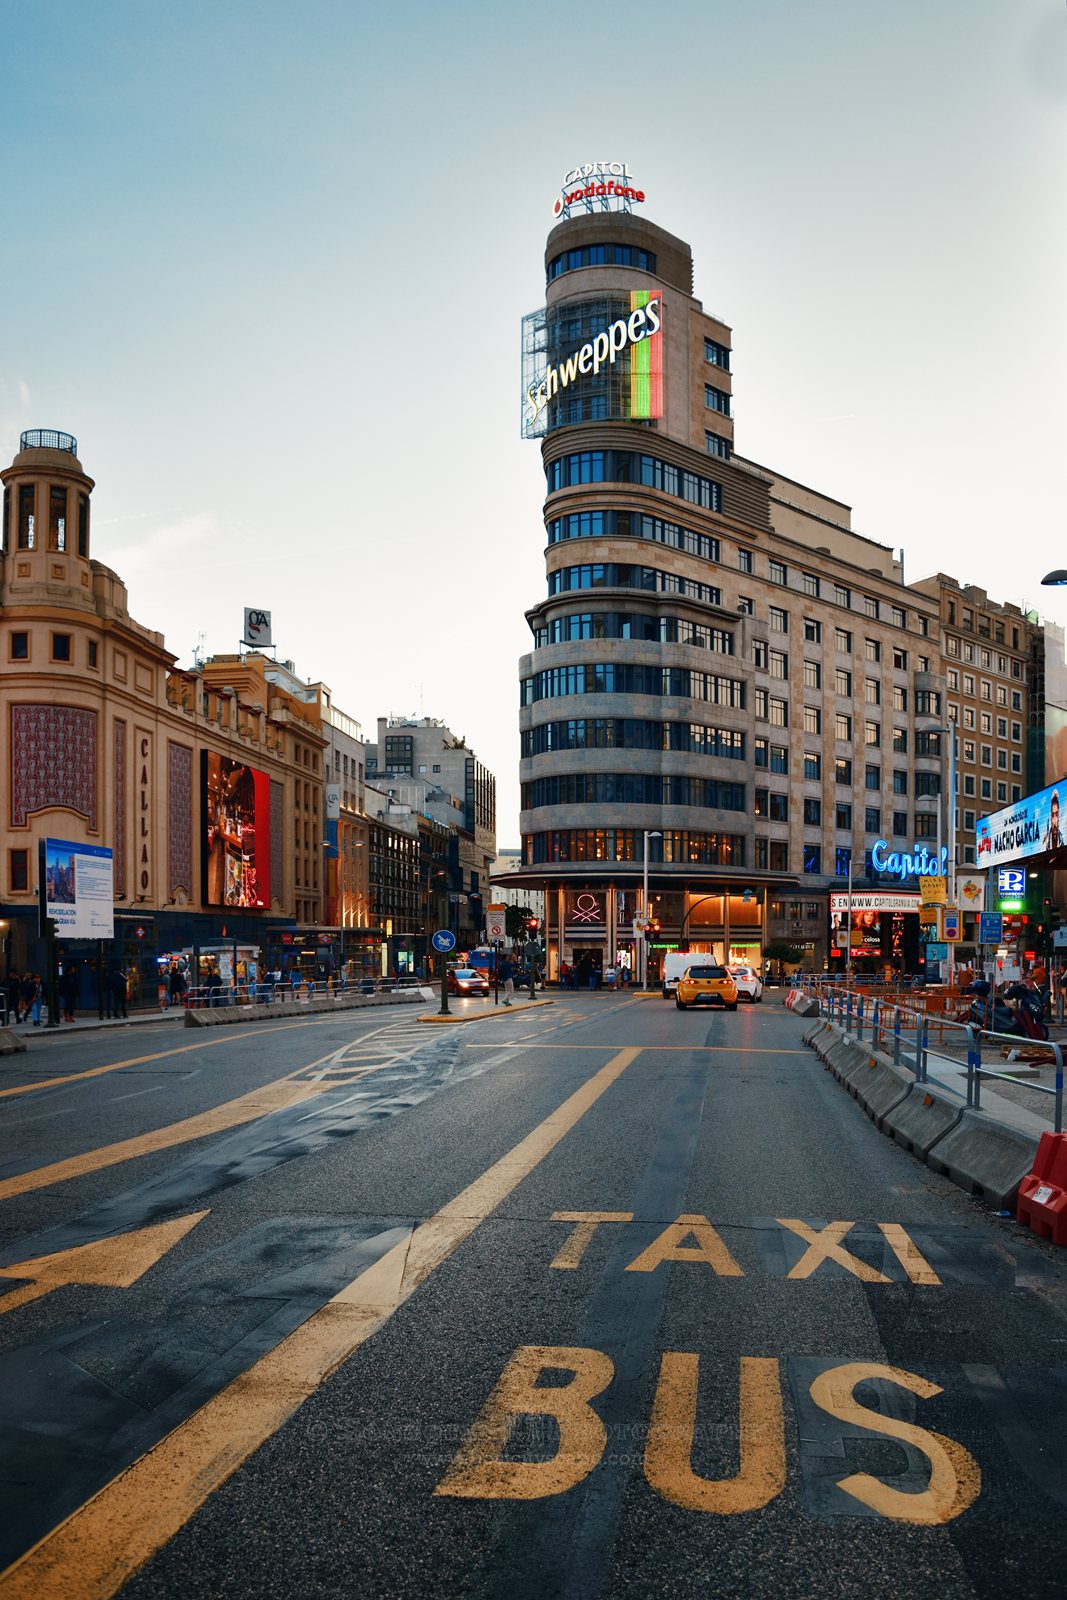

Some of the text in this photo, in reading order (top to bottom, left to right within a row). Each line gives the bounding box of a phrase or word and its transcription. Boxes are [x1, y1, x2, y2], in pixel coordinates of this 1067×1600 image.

[563, 161, 633, 186] CAPITOL
[565, 180, 645, 204] vodafone
[527, 299, 661, 427] Schweppes
[140, 738, 149, 890] CALLAO
[994, 829, 1014, 854] NACHO
[1015, 812, 1040, 848] GARCÍA
[872, 839, 947, 881] Capitol
[838, 898, 848, 907] EN
[549, 1210, 943, 1285] TAXI
[432, 1345, 982, 1527] BUS
